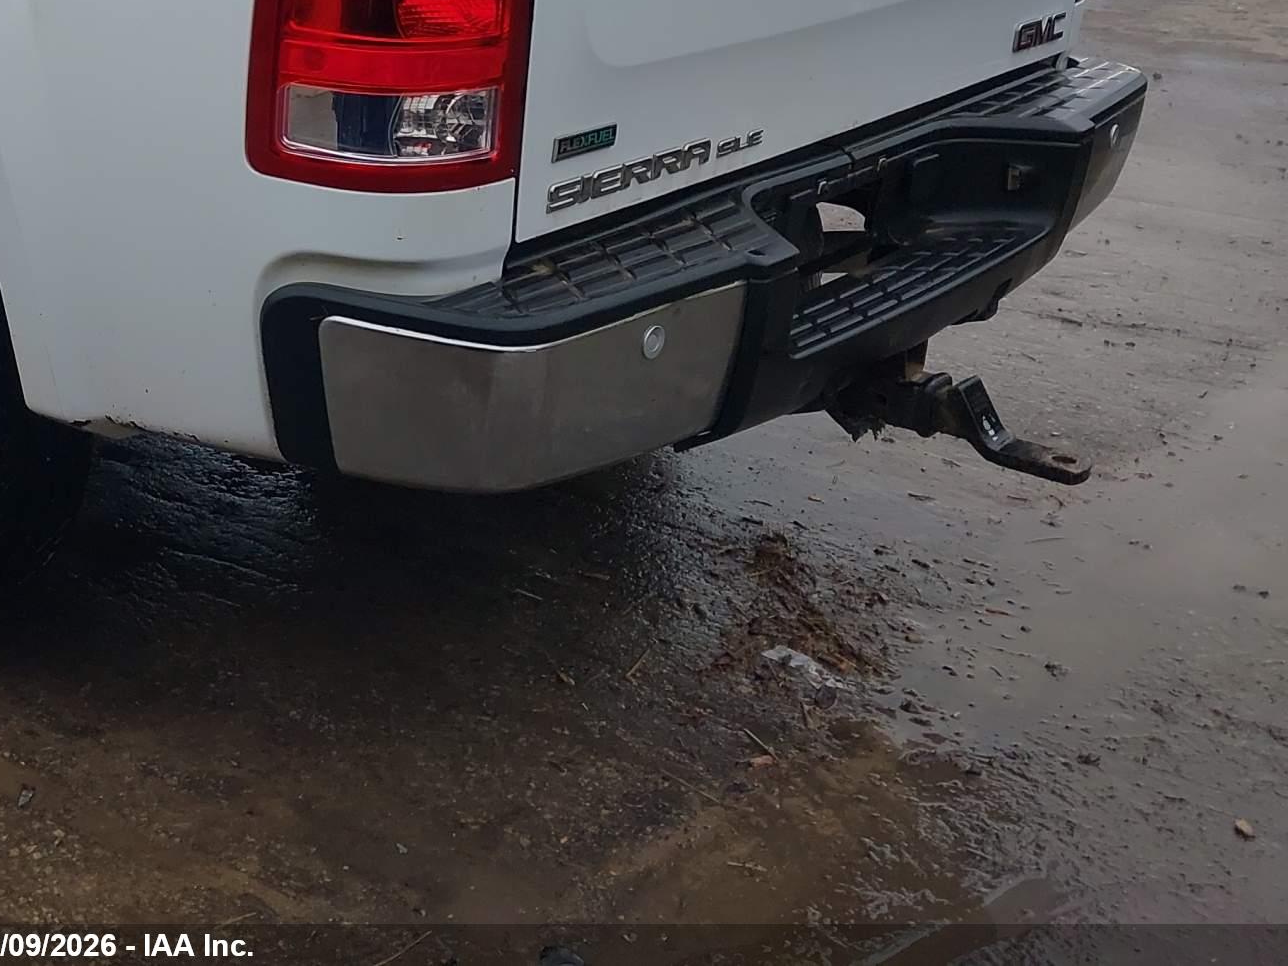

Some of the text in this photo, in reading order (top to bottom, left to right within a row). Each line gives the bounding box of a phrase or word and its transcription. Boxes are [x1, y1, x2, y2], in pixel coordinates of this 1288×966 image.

[1012, 11, 1067, 53] GMC
[545, 128, 764, 214] SIERRA SLE
